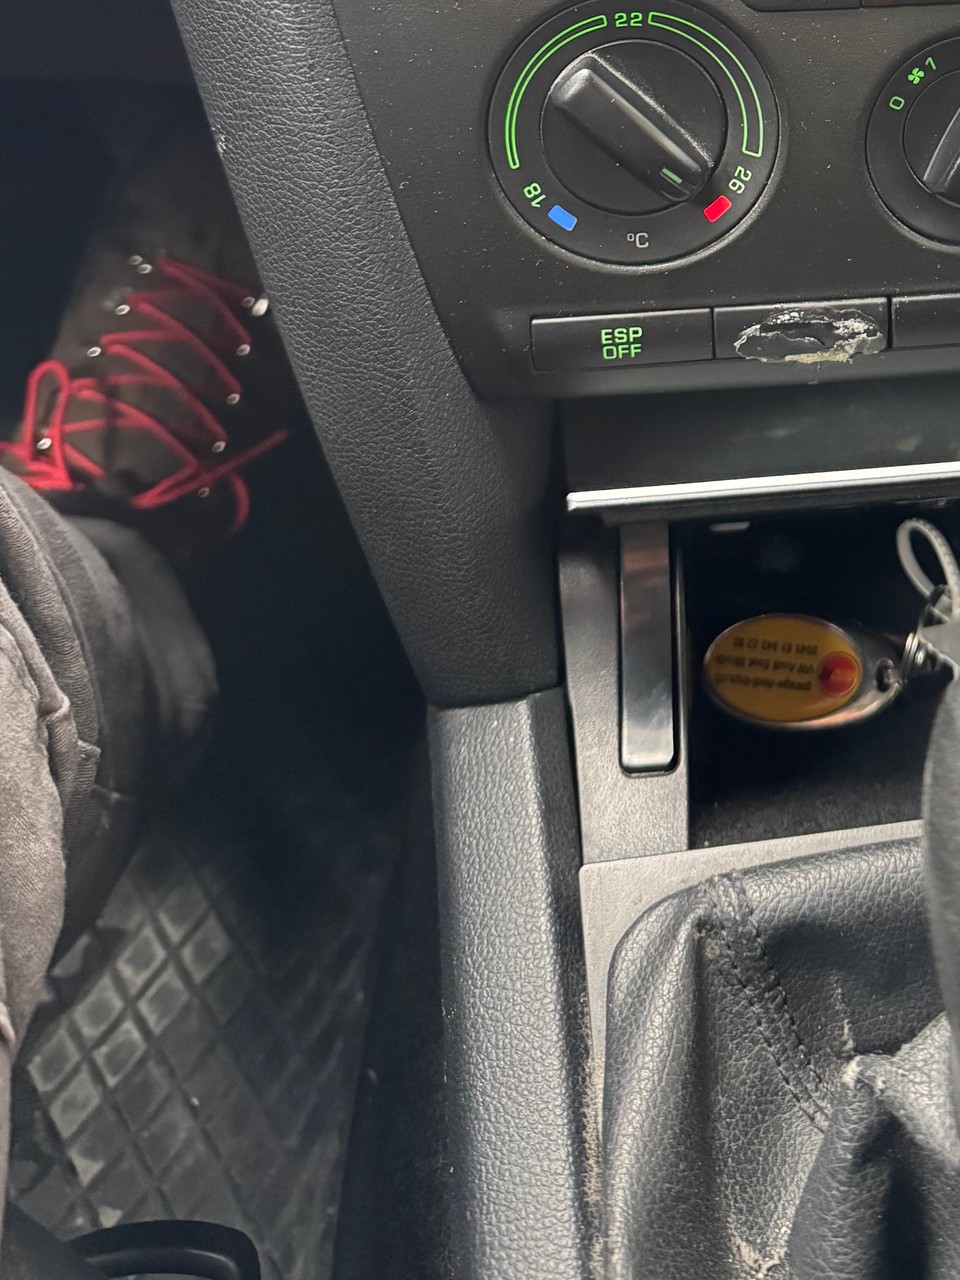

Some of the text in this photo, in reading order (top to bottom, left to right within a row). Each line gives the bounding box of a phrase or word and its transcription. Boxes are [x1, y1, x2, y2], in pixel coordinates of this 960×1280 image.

[614, 12, 643, 28] 22
[925, 56, 937, 70] 1
[728, 165, 752, 195] 26
[523, 182, 547, 208] 18
[600, 326, 643, 345] ESP
[602, 344, 642, 360] OFF
